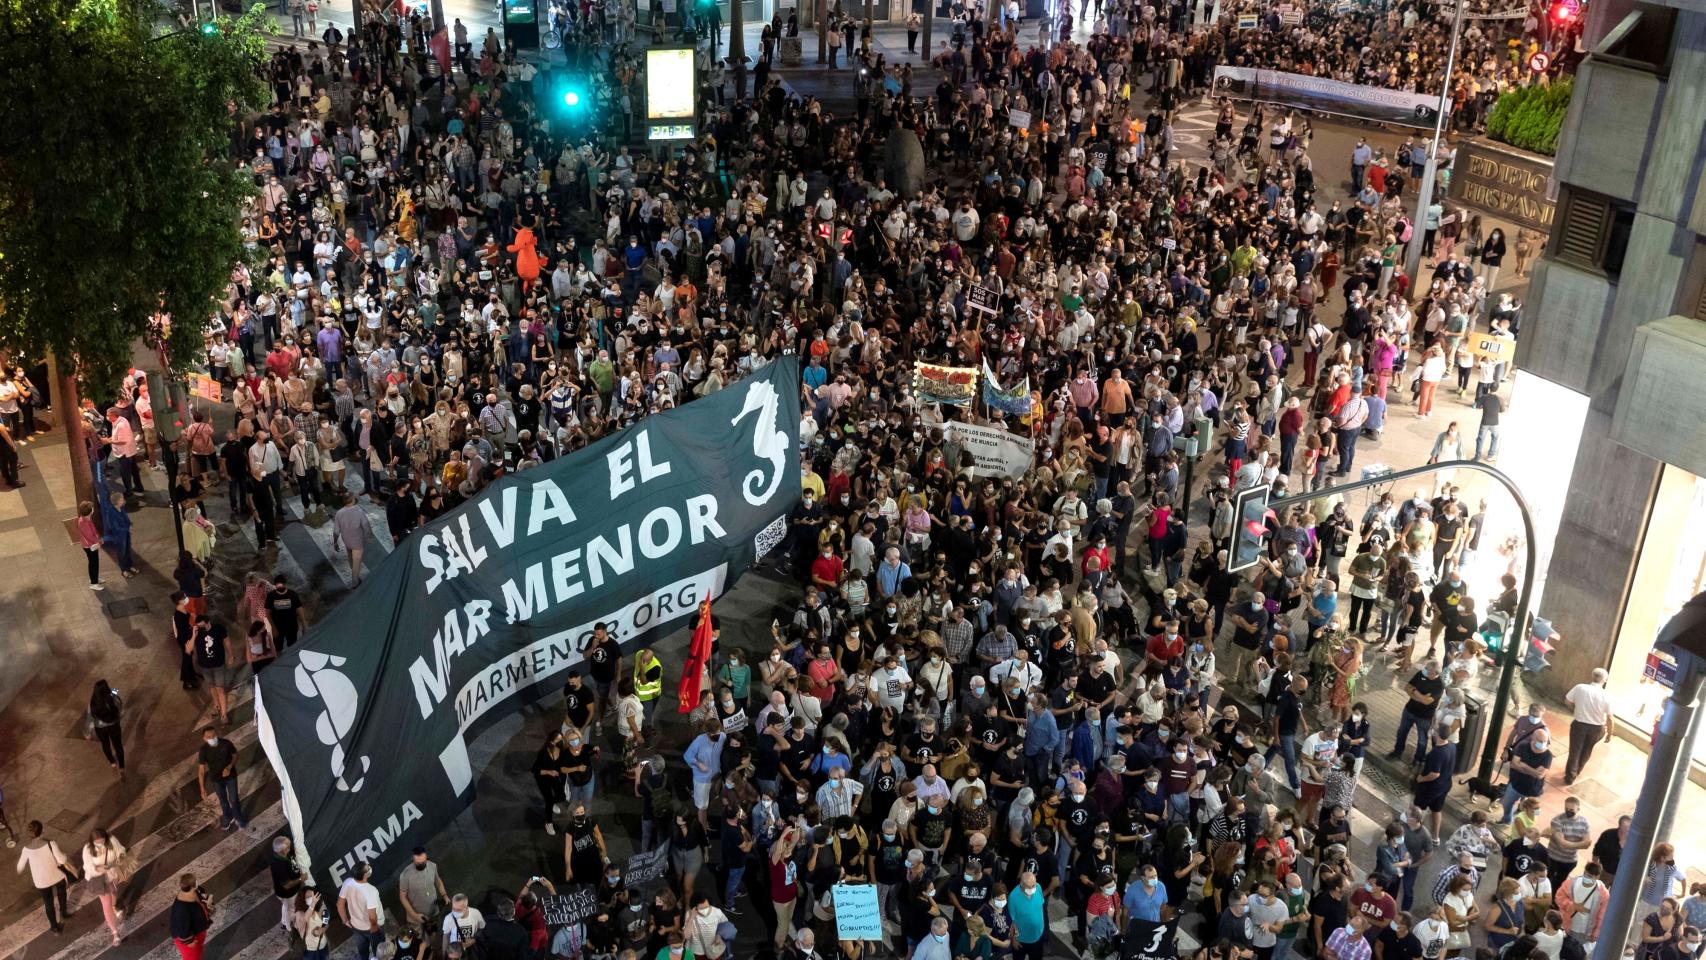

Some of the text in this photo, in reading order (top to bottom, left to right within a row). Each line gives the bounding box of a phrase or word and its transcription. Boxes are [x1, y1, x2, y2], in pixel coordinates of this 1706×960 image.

[1348, 89, 1365, 98] SIN
[973, 294, 985, 302] MAR
[974, 287, 986, 296] SOS
[420, 429, 671, 594] SALVA EL
[408, 493, 727, 720] MAR MENOR
[328, 800, 423, 888] FIRMA
[1360, 902, 1383, 918] GAP
